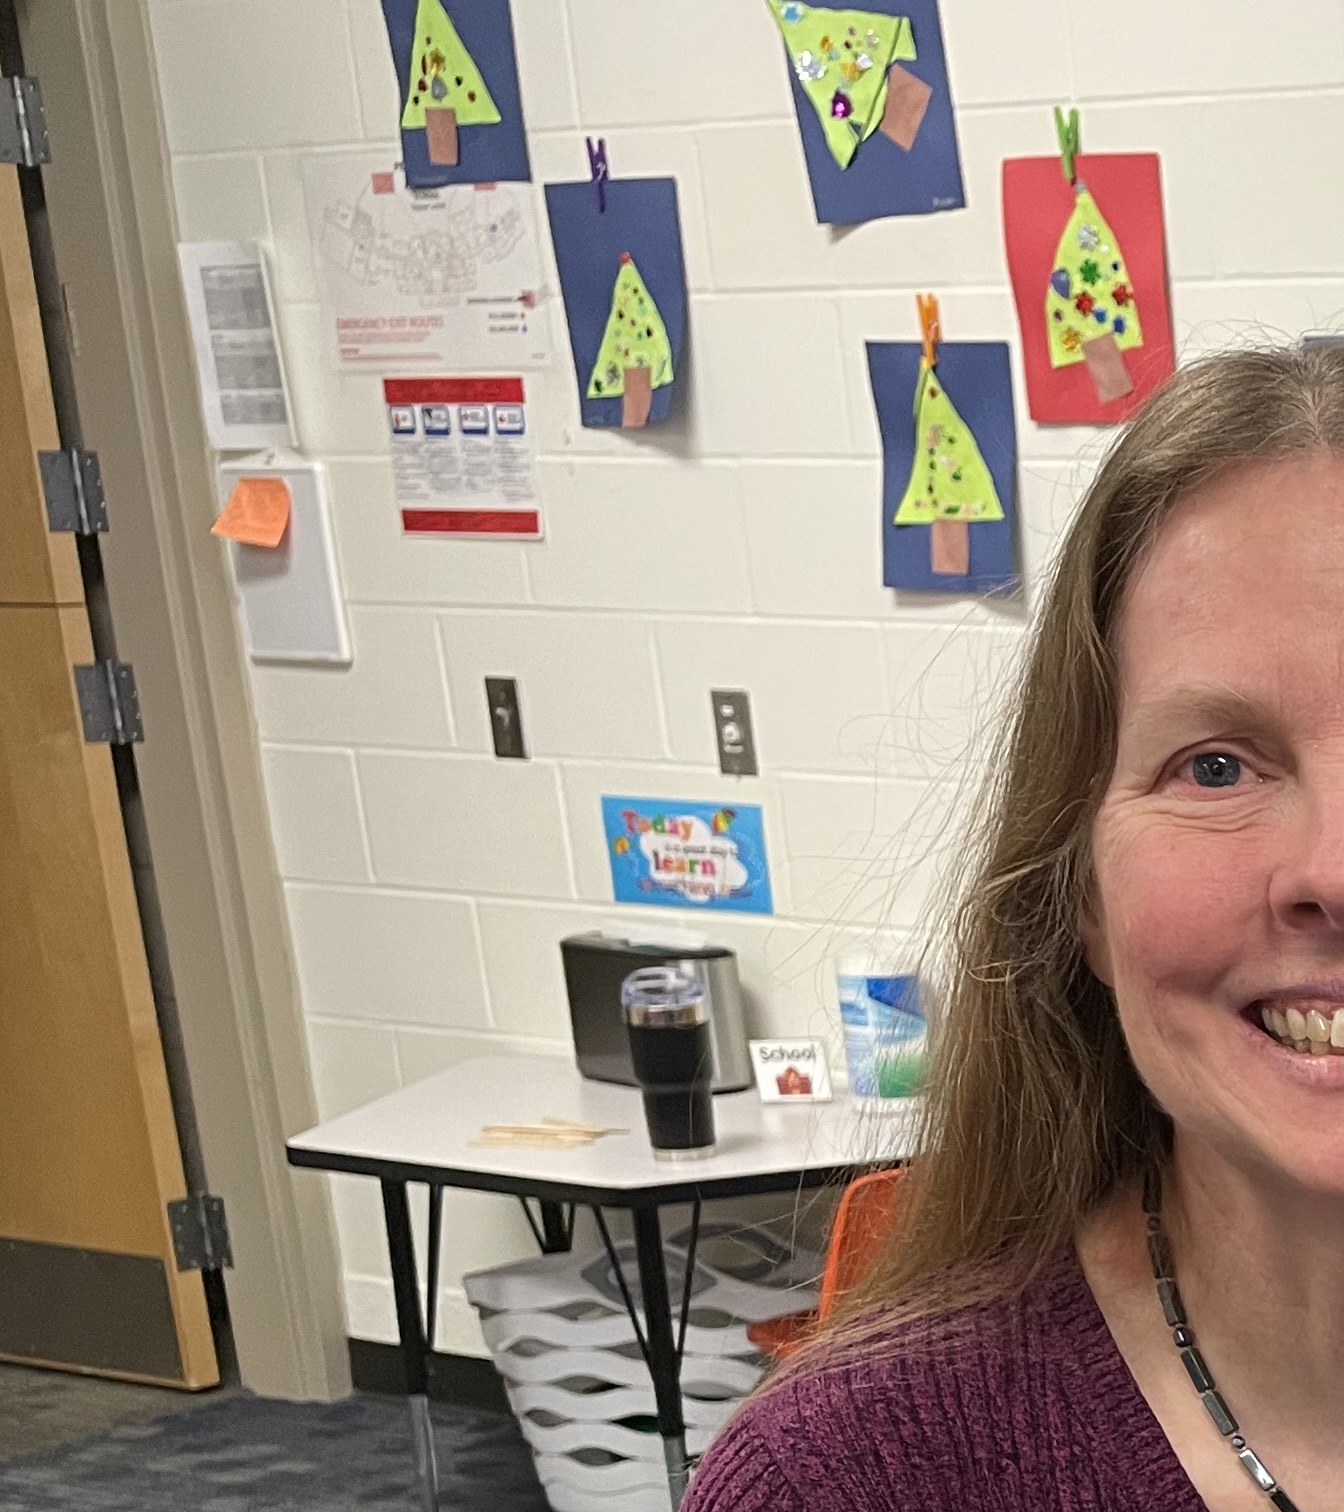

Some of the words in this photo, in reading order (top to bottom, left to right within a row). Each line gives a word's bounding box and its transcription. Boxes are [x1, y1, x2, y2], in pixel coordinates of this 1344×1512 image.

[621, 809, 692, 841] Today
[653, 848, 716, 876] learn
[758, 1044, 816, 1064] School
